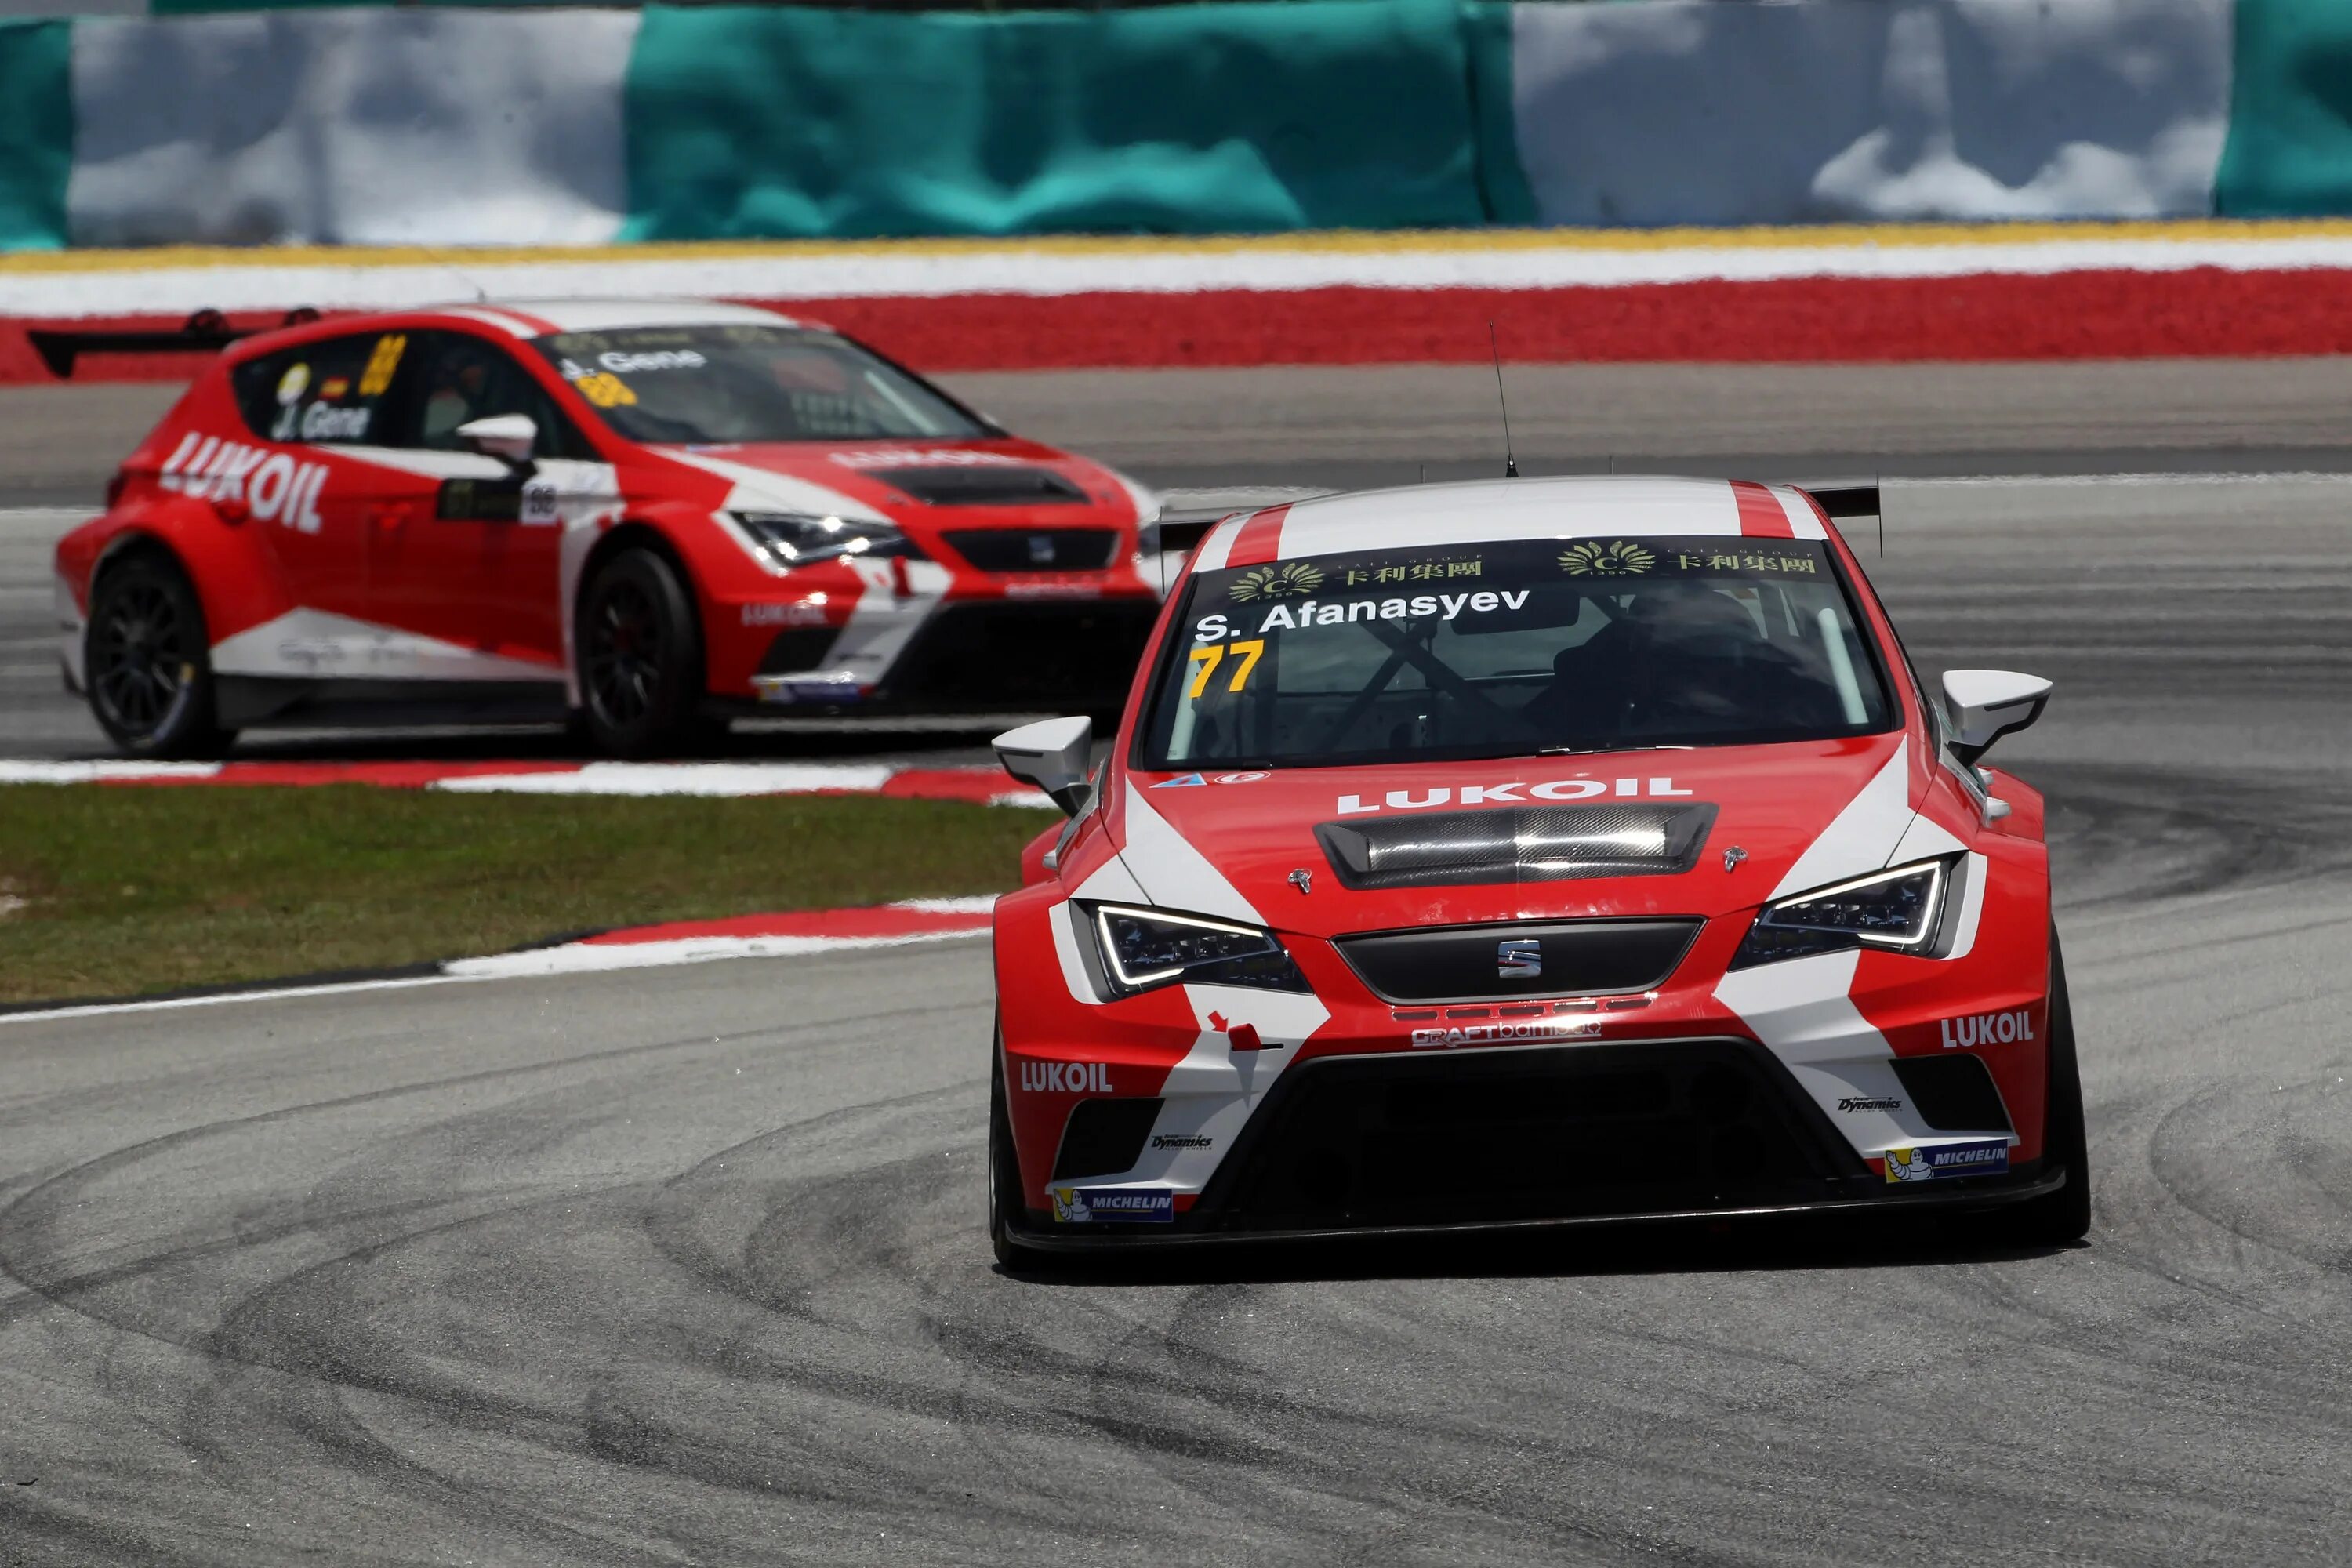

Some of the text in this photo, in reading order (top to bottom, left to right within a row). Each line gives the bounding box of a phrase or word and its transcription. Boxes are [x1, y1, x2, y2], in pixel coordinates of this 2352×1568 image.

[599, 350, 707, 372] Gene
[301, 399, 371, 440] Gene
[158, 430, 330, 535] LUKOIL
[1334, 561, 1482, 586] 卡利集團
[1667, 554, 1816, 574] 卡利集團
[1195, 590, 1530, 641] S. Afanasyev
[1188, 639, 1265, 699] 77
[1337, 777, 1693, 815] LUKOIL
[1941, 1011, 2034, 1048] LUKOIL
[1022, 1062, 1112, 1092] LUKOIL
[1838, 1097, 1902, 1113] Dynamics
[1152, 1134, 1213, 1151] Dynamics
[1934, 1147, 2007, 1166] MICHELIN
[1093, 1196, 1171, 1210] MICHELIN
